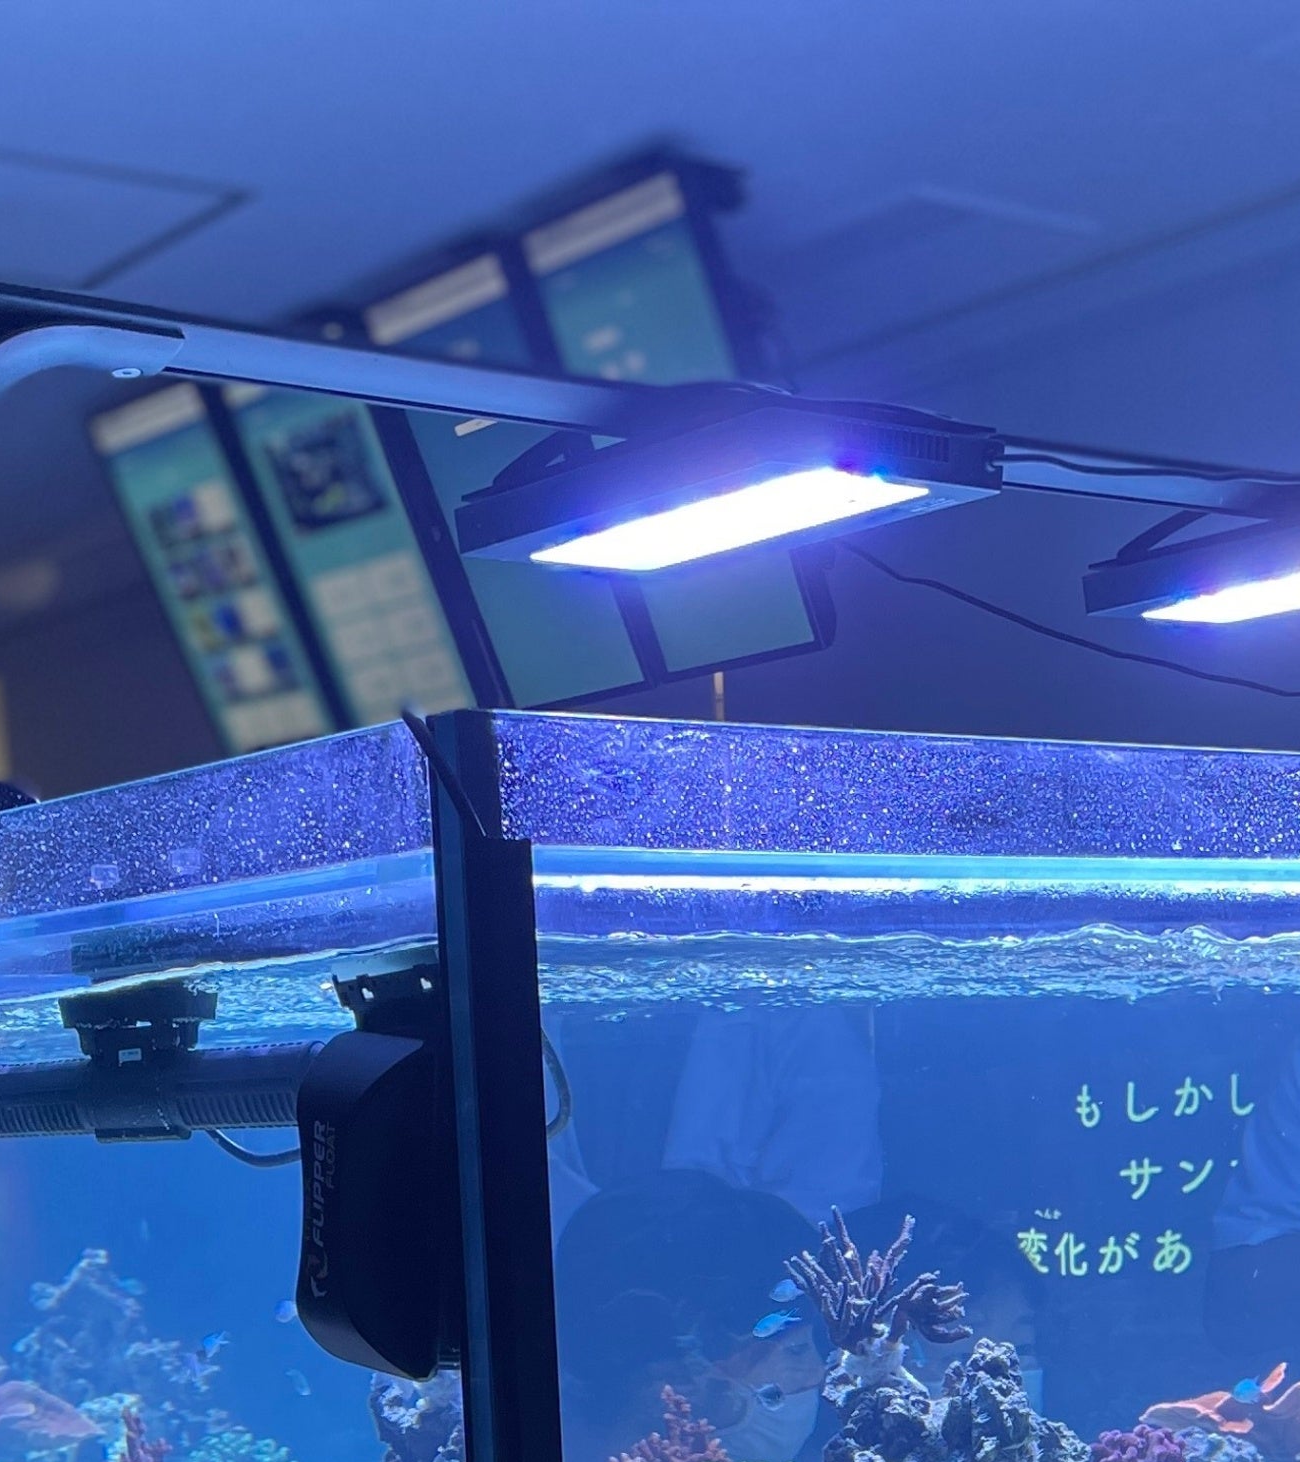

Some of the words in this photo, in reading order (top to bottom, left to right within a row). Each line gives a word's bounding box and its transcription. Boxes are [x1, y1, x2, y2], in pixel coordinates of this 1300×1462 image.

[1075, 1073, 1255, 1128] もしかし
[324, 1121, 337, 1190] FLOAT
[1119, 1157, 1239, 1201] サン
[313, 1120, 326, 1247] FLIPPER
[1017, 1227, 1193, 1277] 変化があ
